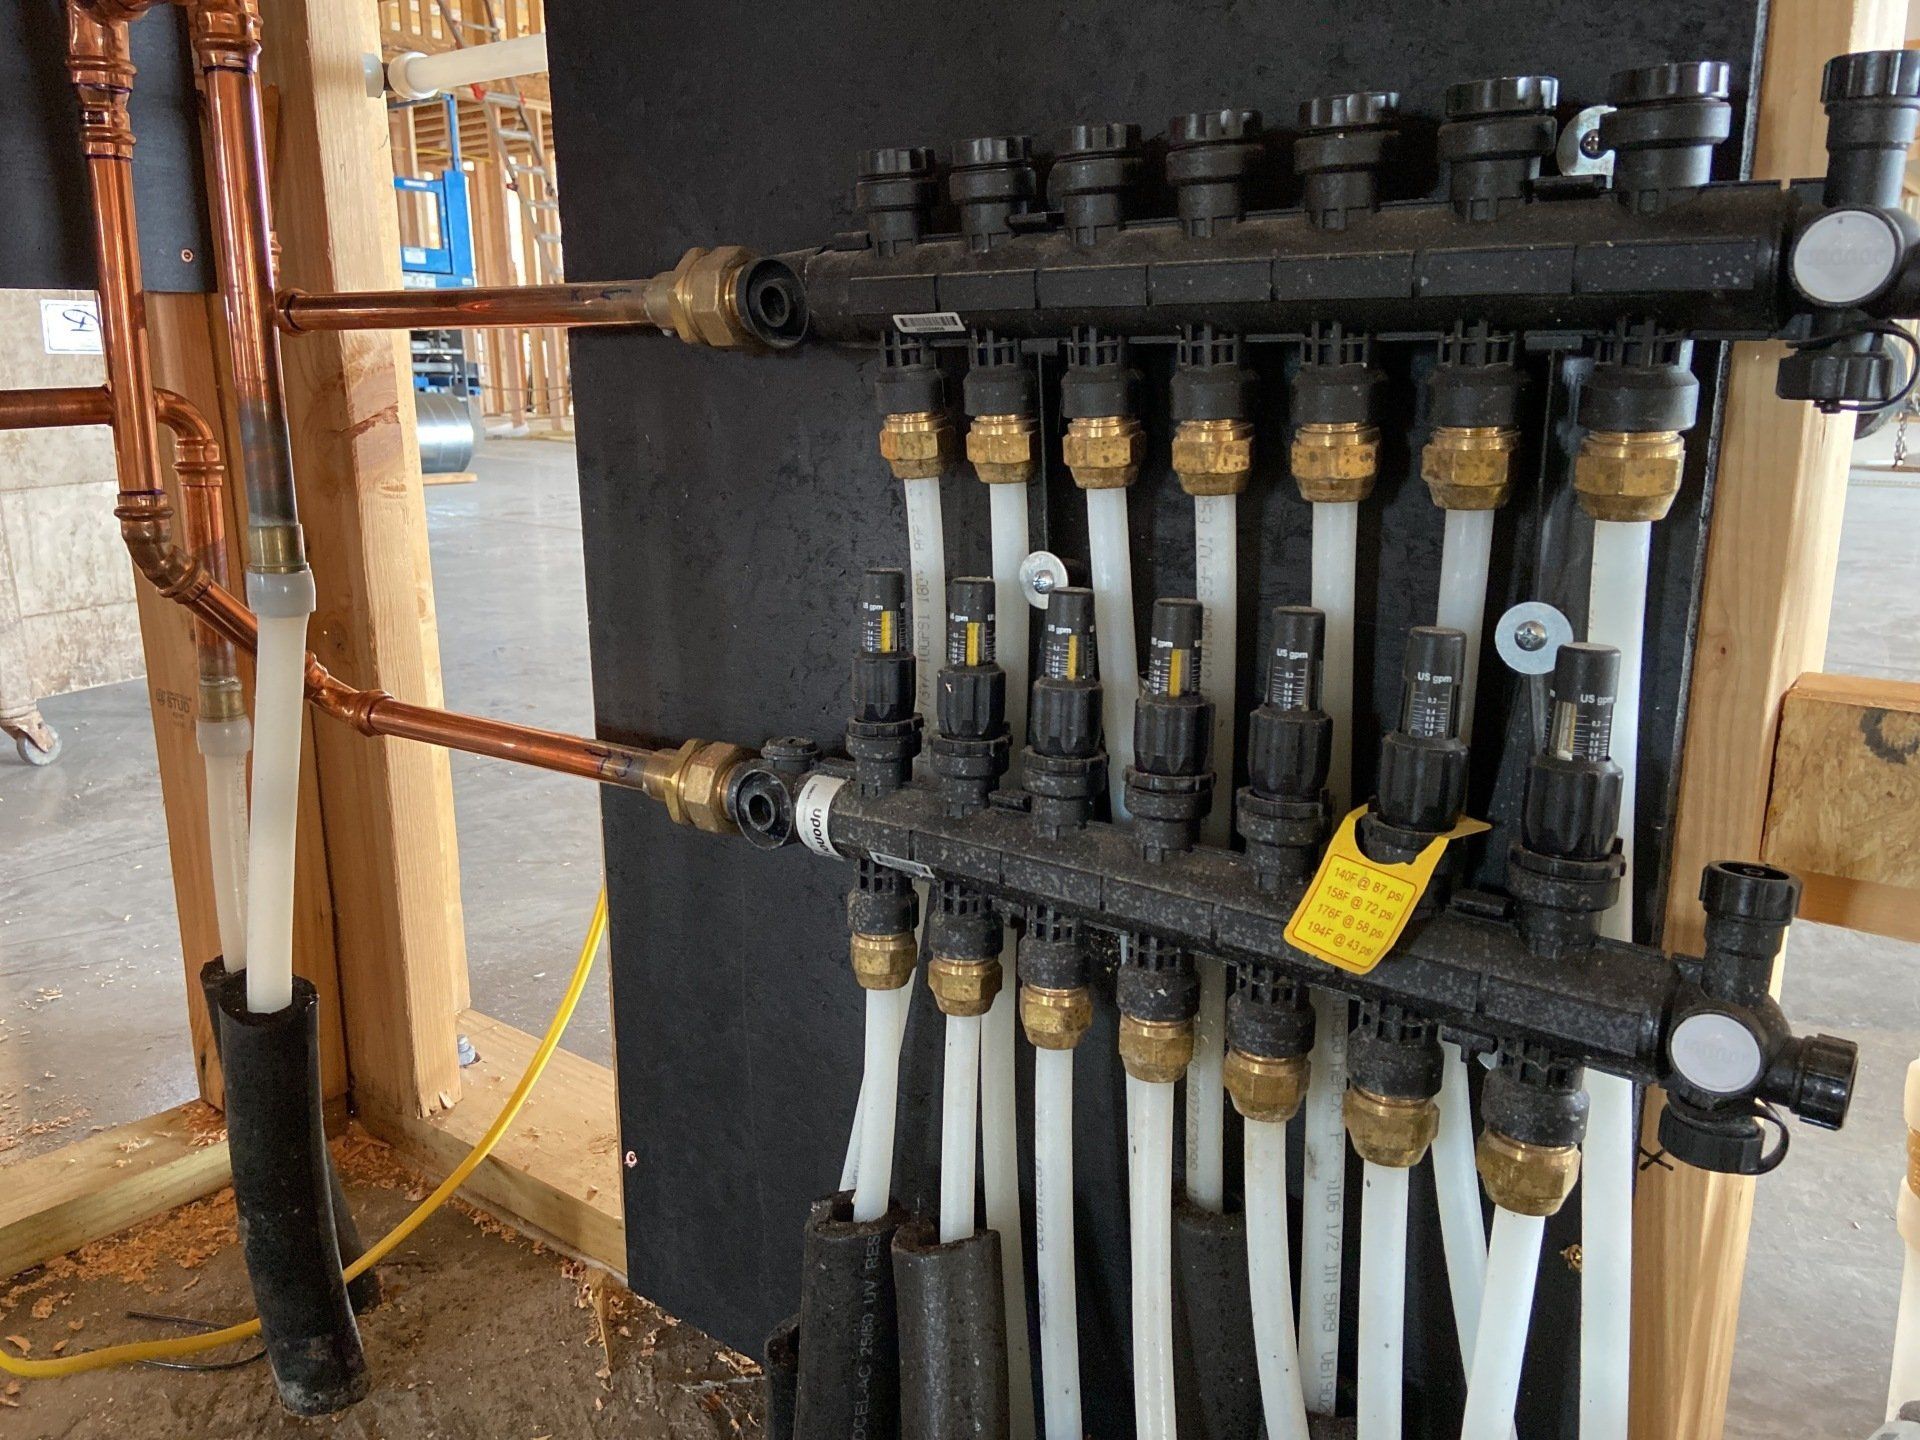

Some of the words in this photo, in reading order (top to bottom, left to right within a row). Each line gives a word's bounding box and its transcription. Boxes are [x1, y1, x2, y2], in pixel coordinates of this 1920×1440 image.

[1276, 648, 1288, 657] US
[1289, 651, 1308, 660] gpm
[1417, 672, 1431, 681] US
[1433, 675, 1452, 685] gpm
[1580, 694, 1595, 704] US
[1597, 696, 1614, 706] gpm
[1334, 866, 1358, 883] 140F
[1357, 877, 1371, 890] @
[1372, 882, 1387, 895] 87
[1387, 889, 1404, 902] psi
[1327, 885, 1350, 901] 158F
[1351, 896, 1363, 910] @
[1365, 901, 1379, 914] 72
[1379, 908, 1395, 922] psi
[1317, 903, 1342, 921] 176F
[1342, 915, 1355, 928] @
[1357, 920, 1370, 933] 58
[1369, 928, 1385, 941] psi
[1307, 921, 1333, 938] 194F
[1333, 933, 1346, 947] @
[1347, 938, 1360, 950] 43
[1359, 945, 1374, 957] psi
[864, 1235, 881, 1270] RES
[1325, 1224, 1340, 1252] 1/2
[1322, 1264, 1338, 1284] IN
[863, 1280, 877, 1304] UV
[1322, 1292, 1338, 1333] SDR9
